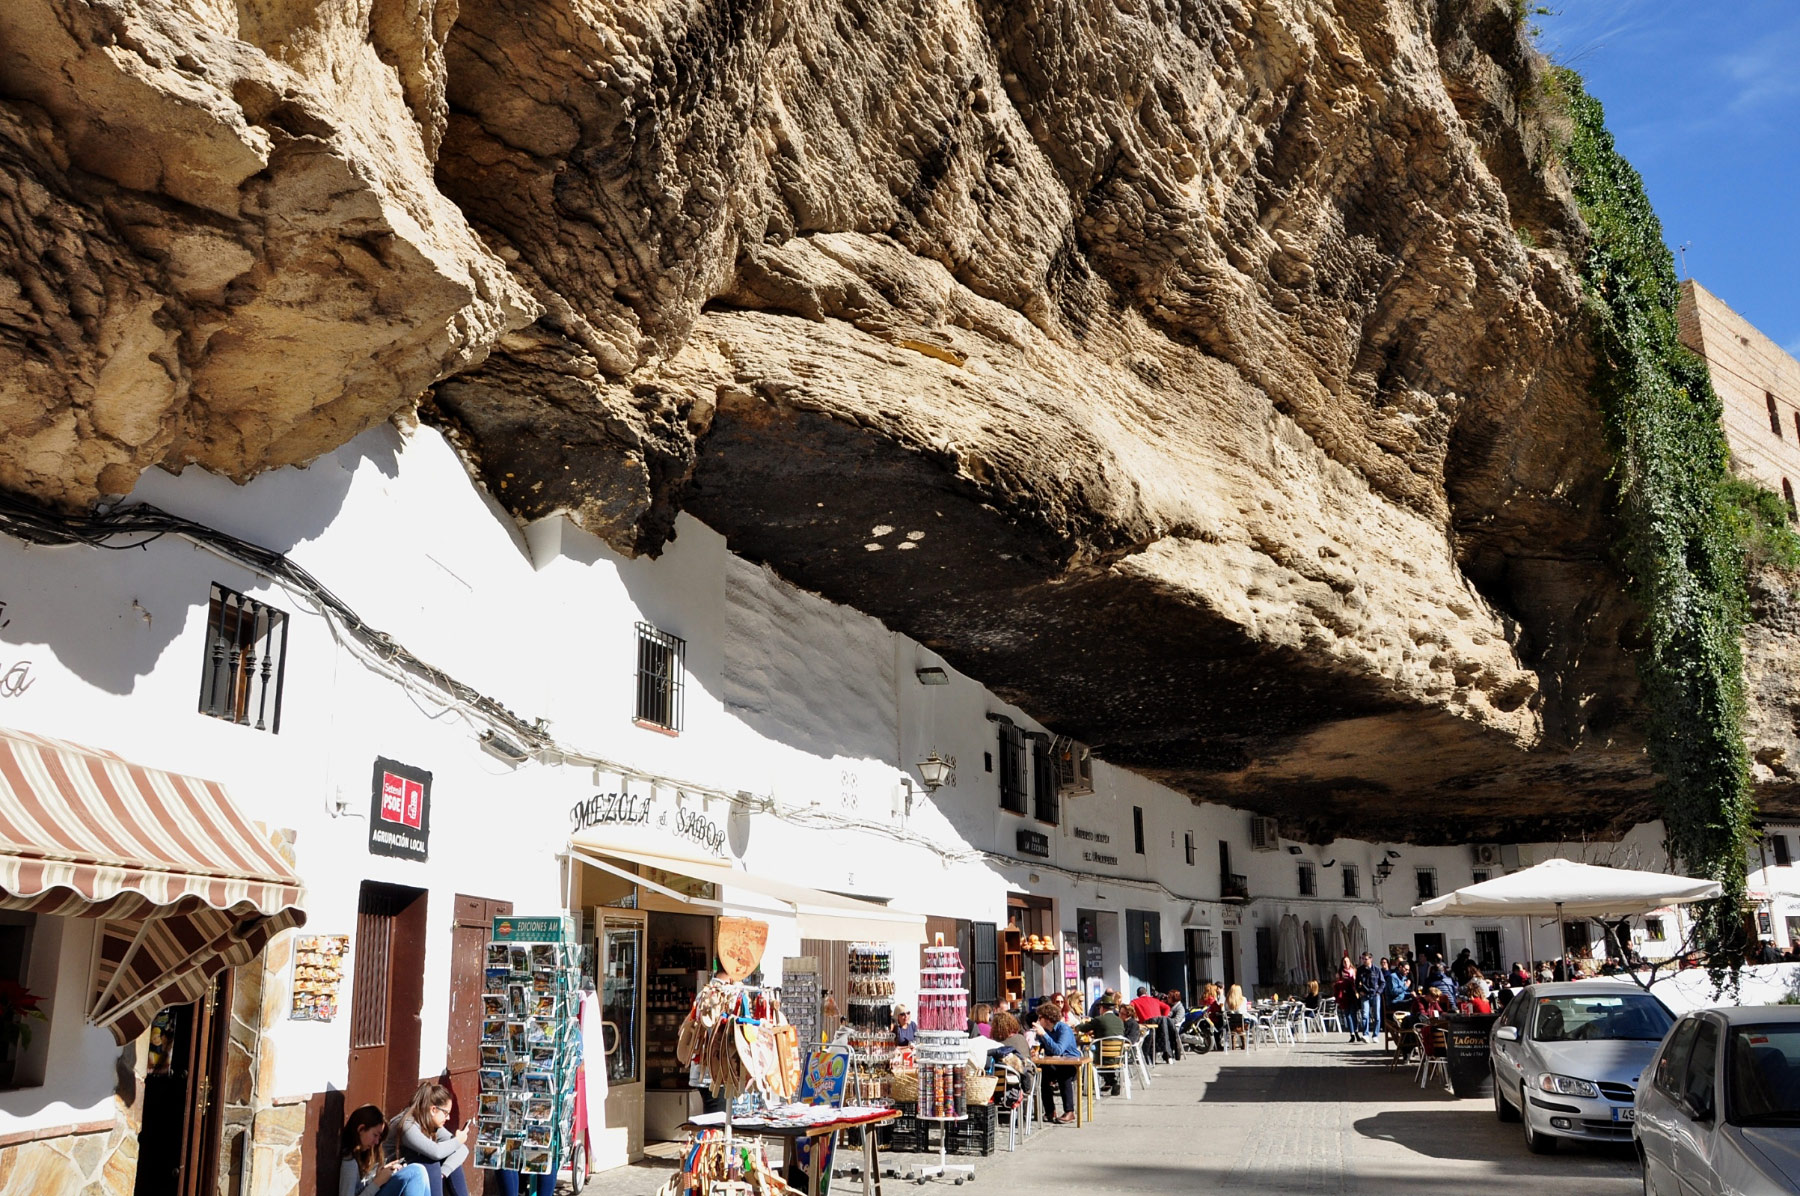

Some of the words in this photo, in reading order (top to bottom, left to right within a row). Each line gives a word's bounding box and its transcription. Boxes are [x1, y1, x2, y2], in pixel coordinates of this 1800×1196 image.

[385, 782, 402, 797] Setenil
[383, 793, 401, 813] PSOE
[574, 792, 651, 832] MEZCLA
[677, 806, 726, 857] SABOR
[372, 829, 409, 848] AGRUPACIÓN
[410, 838, 426, 852] LOCAL
[517, 921, 547, 931] EDICIONES
[548, 921, 558, 931] AM
